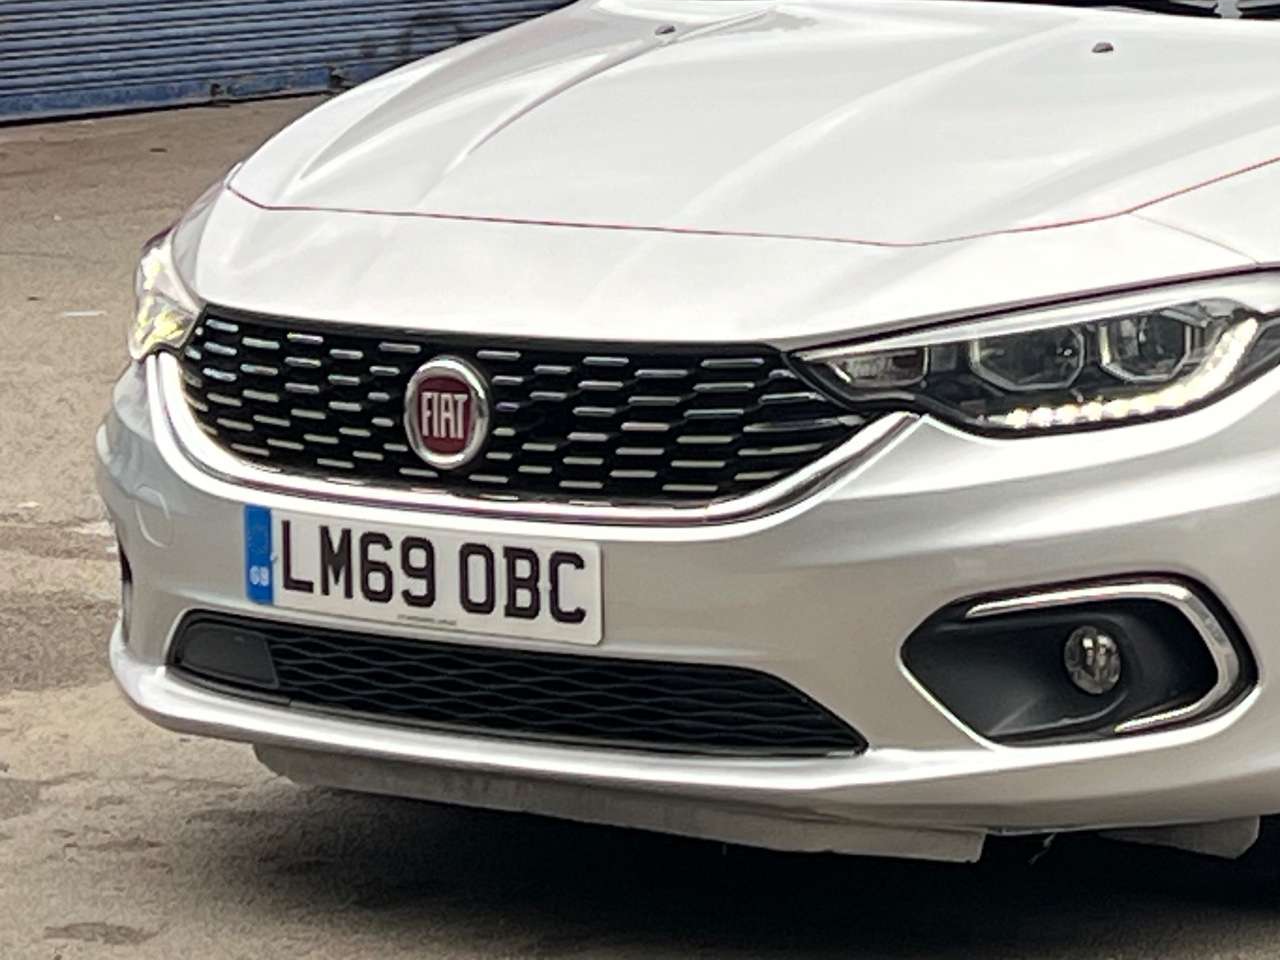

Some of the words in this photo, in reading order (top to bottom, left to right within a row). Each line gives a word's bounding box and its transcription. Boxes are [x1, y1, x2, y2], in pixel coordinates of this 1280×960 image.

[421, 391, 469, 439] FIAT
[281, 519, 436, 608] LM69
[458, 542, 587, 624] OBC
